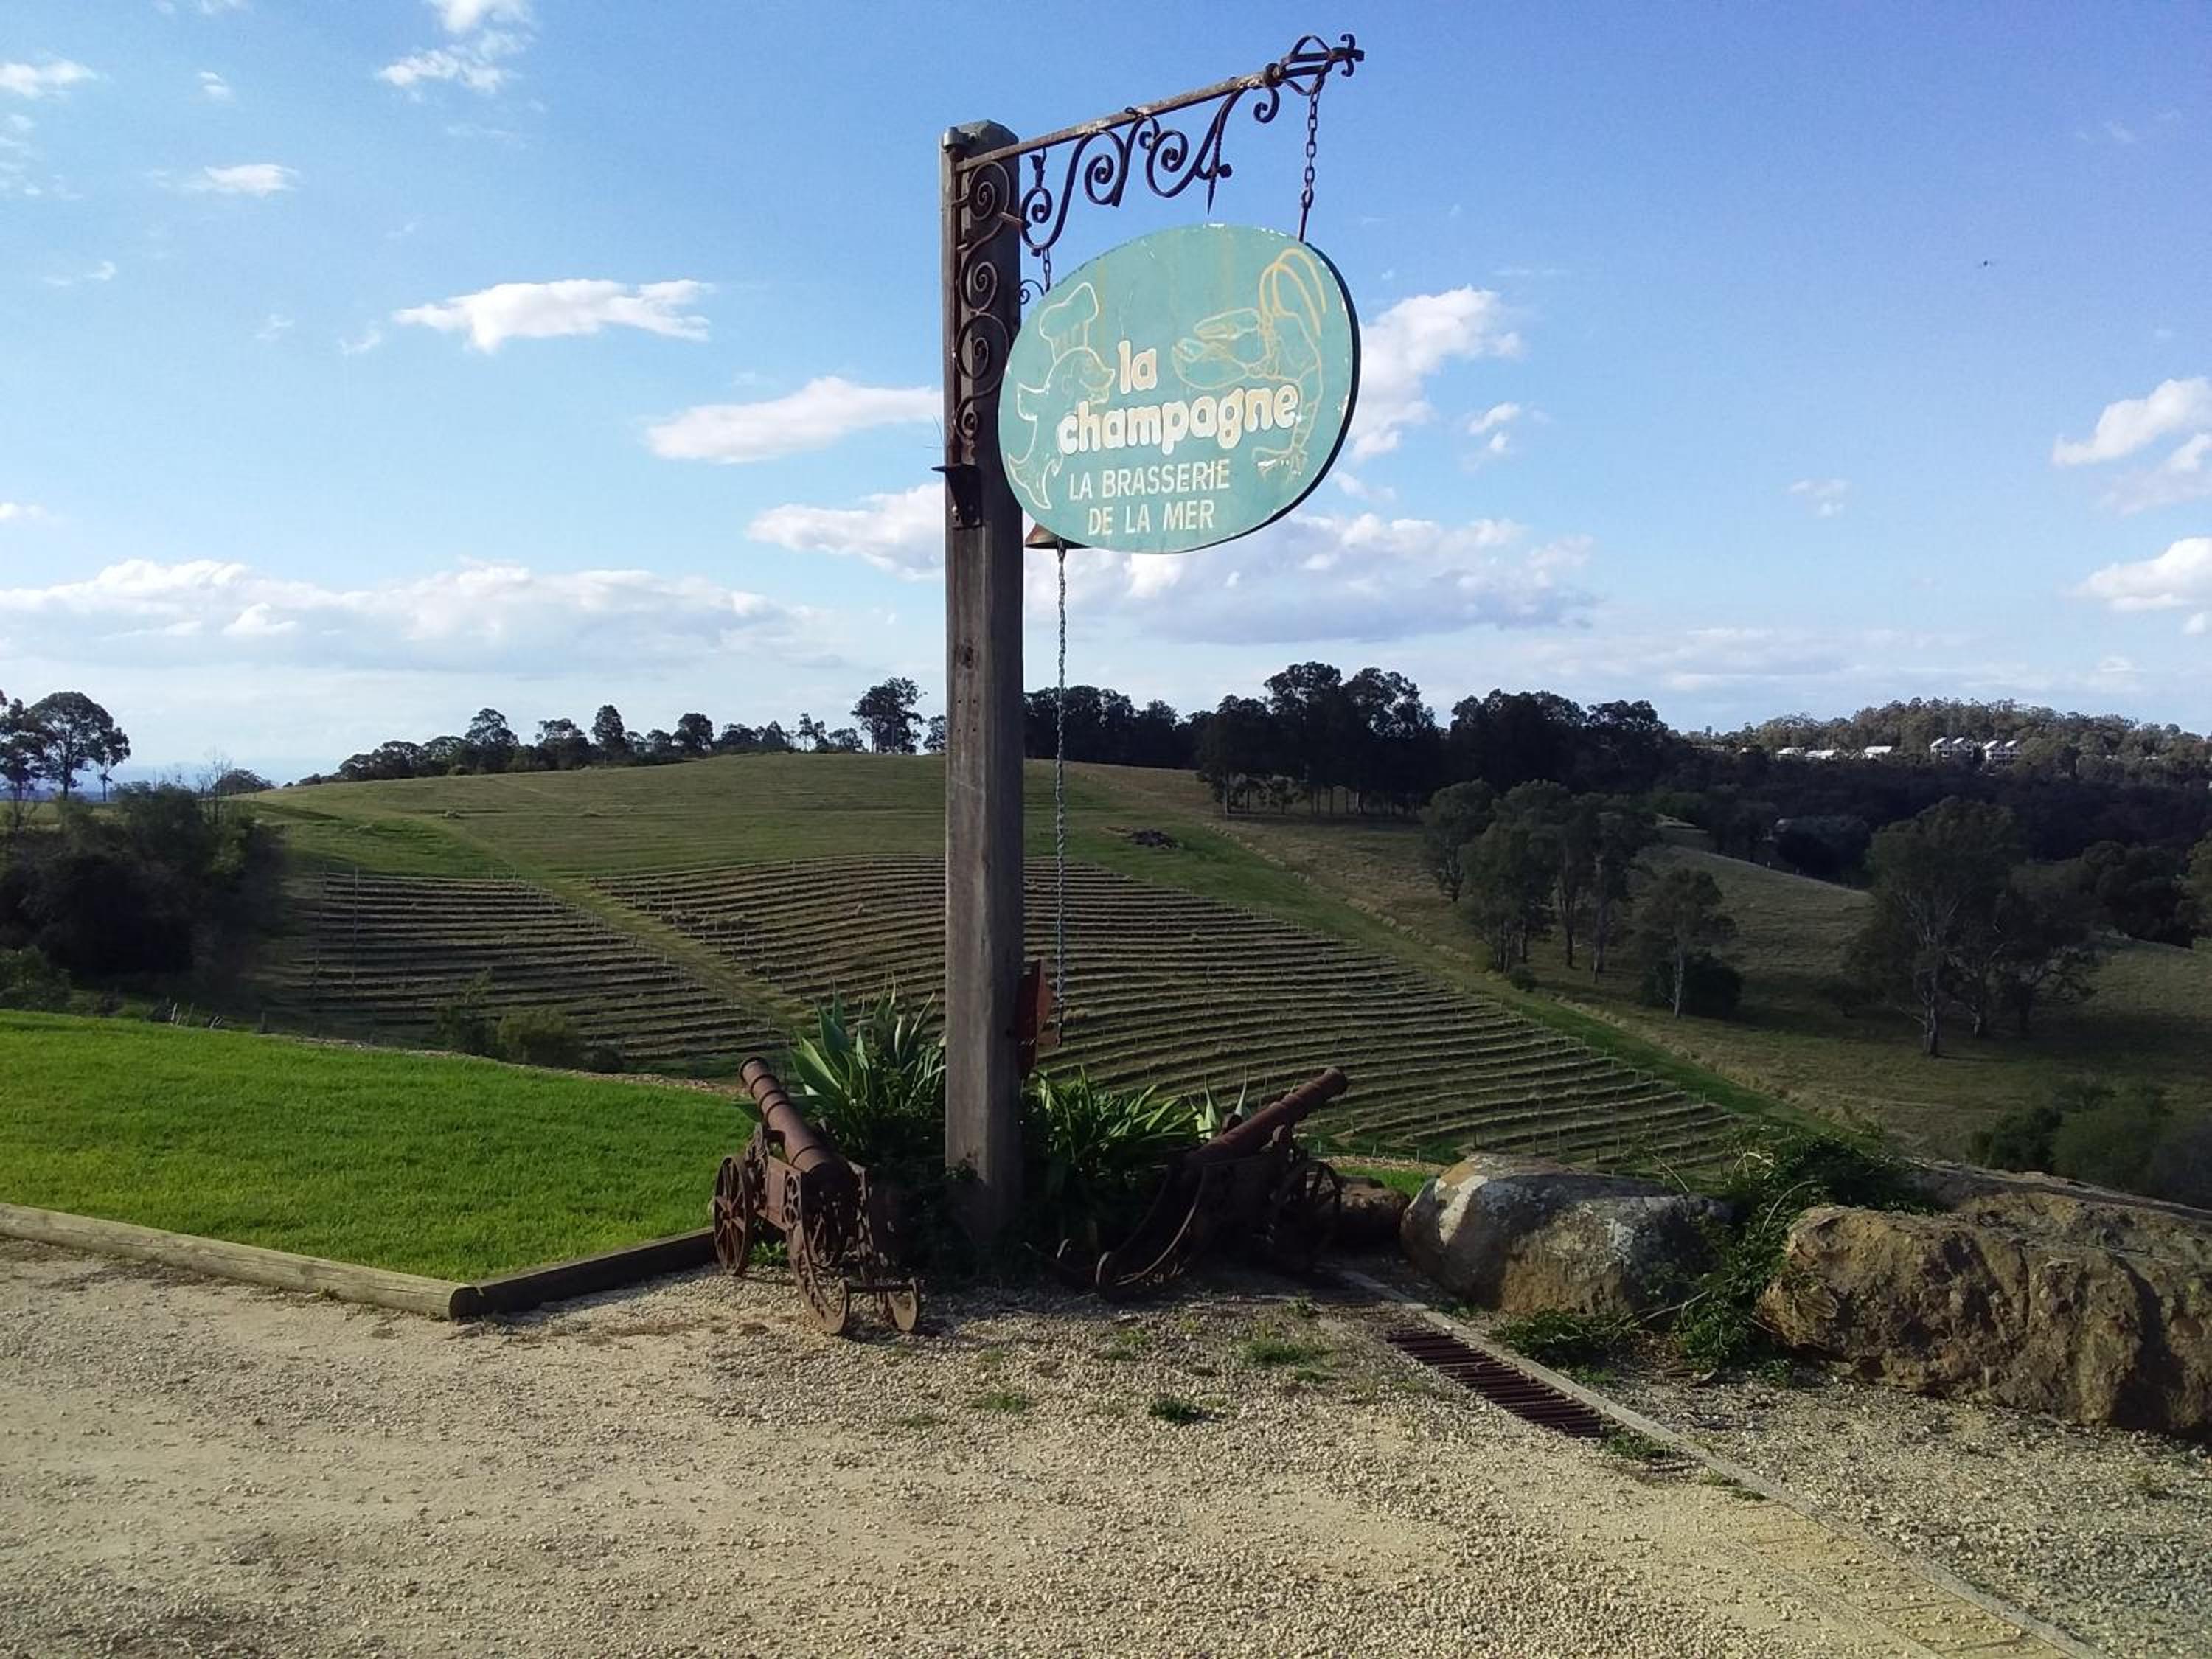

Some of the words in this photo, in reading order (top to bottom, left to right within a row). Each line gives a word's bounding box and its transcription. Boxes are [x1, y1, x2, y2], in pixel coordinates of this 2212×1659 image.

[1118, 339, 1158, 394] la
[1057, 384, 1299, 456] champagne
[1069, 472, 1093, 501] LA
[1102, 459, 1231, 499] BRASSERIE
[1088, 507, 1113, 536] DE
[1125, 504, 1151, 535] LA
[1163, 499, 1215, 532] MER
